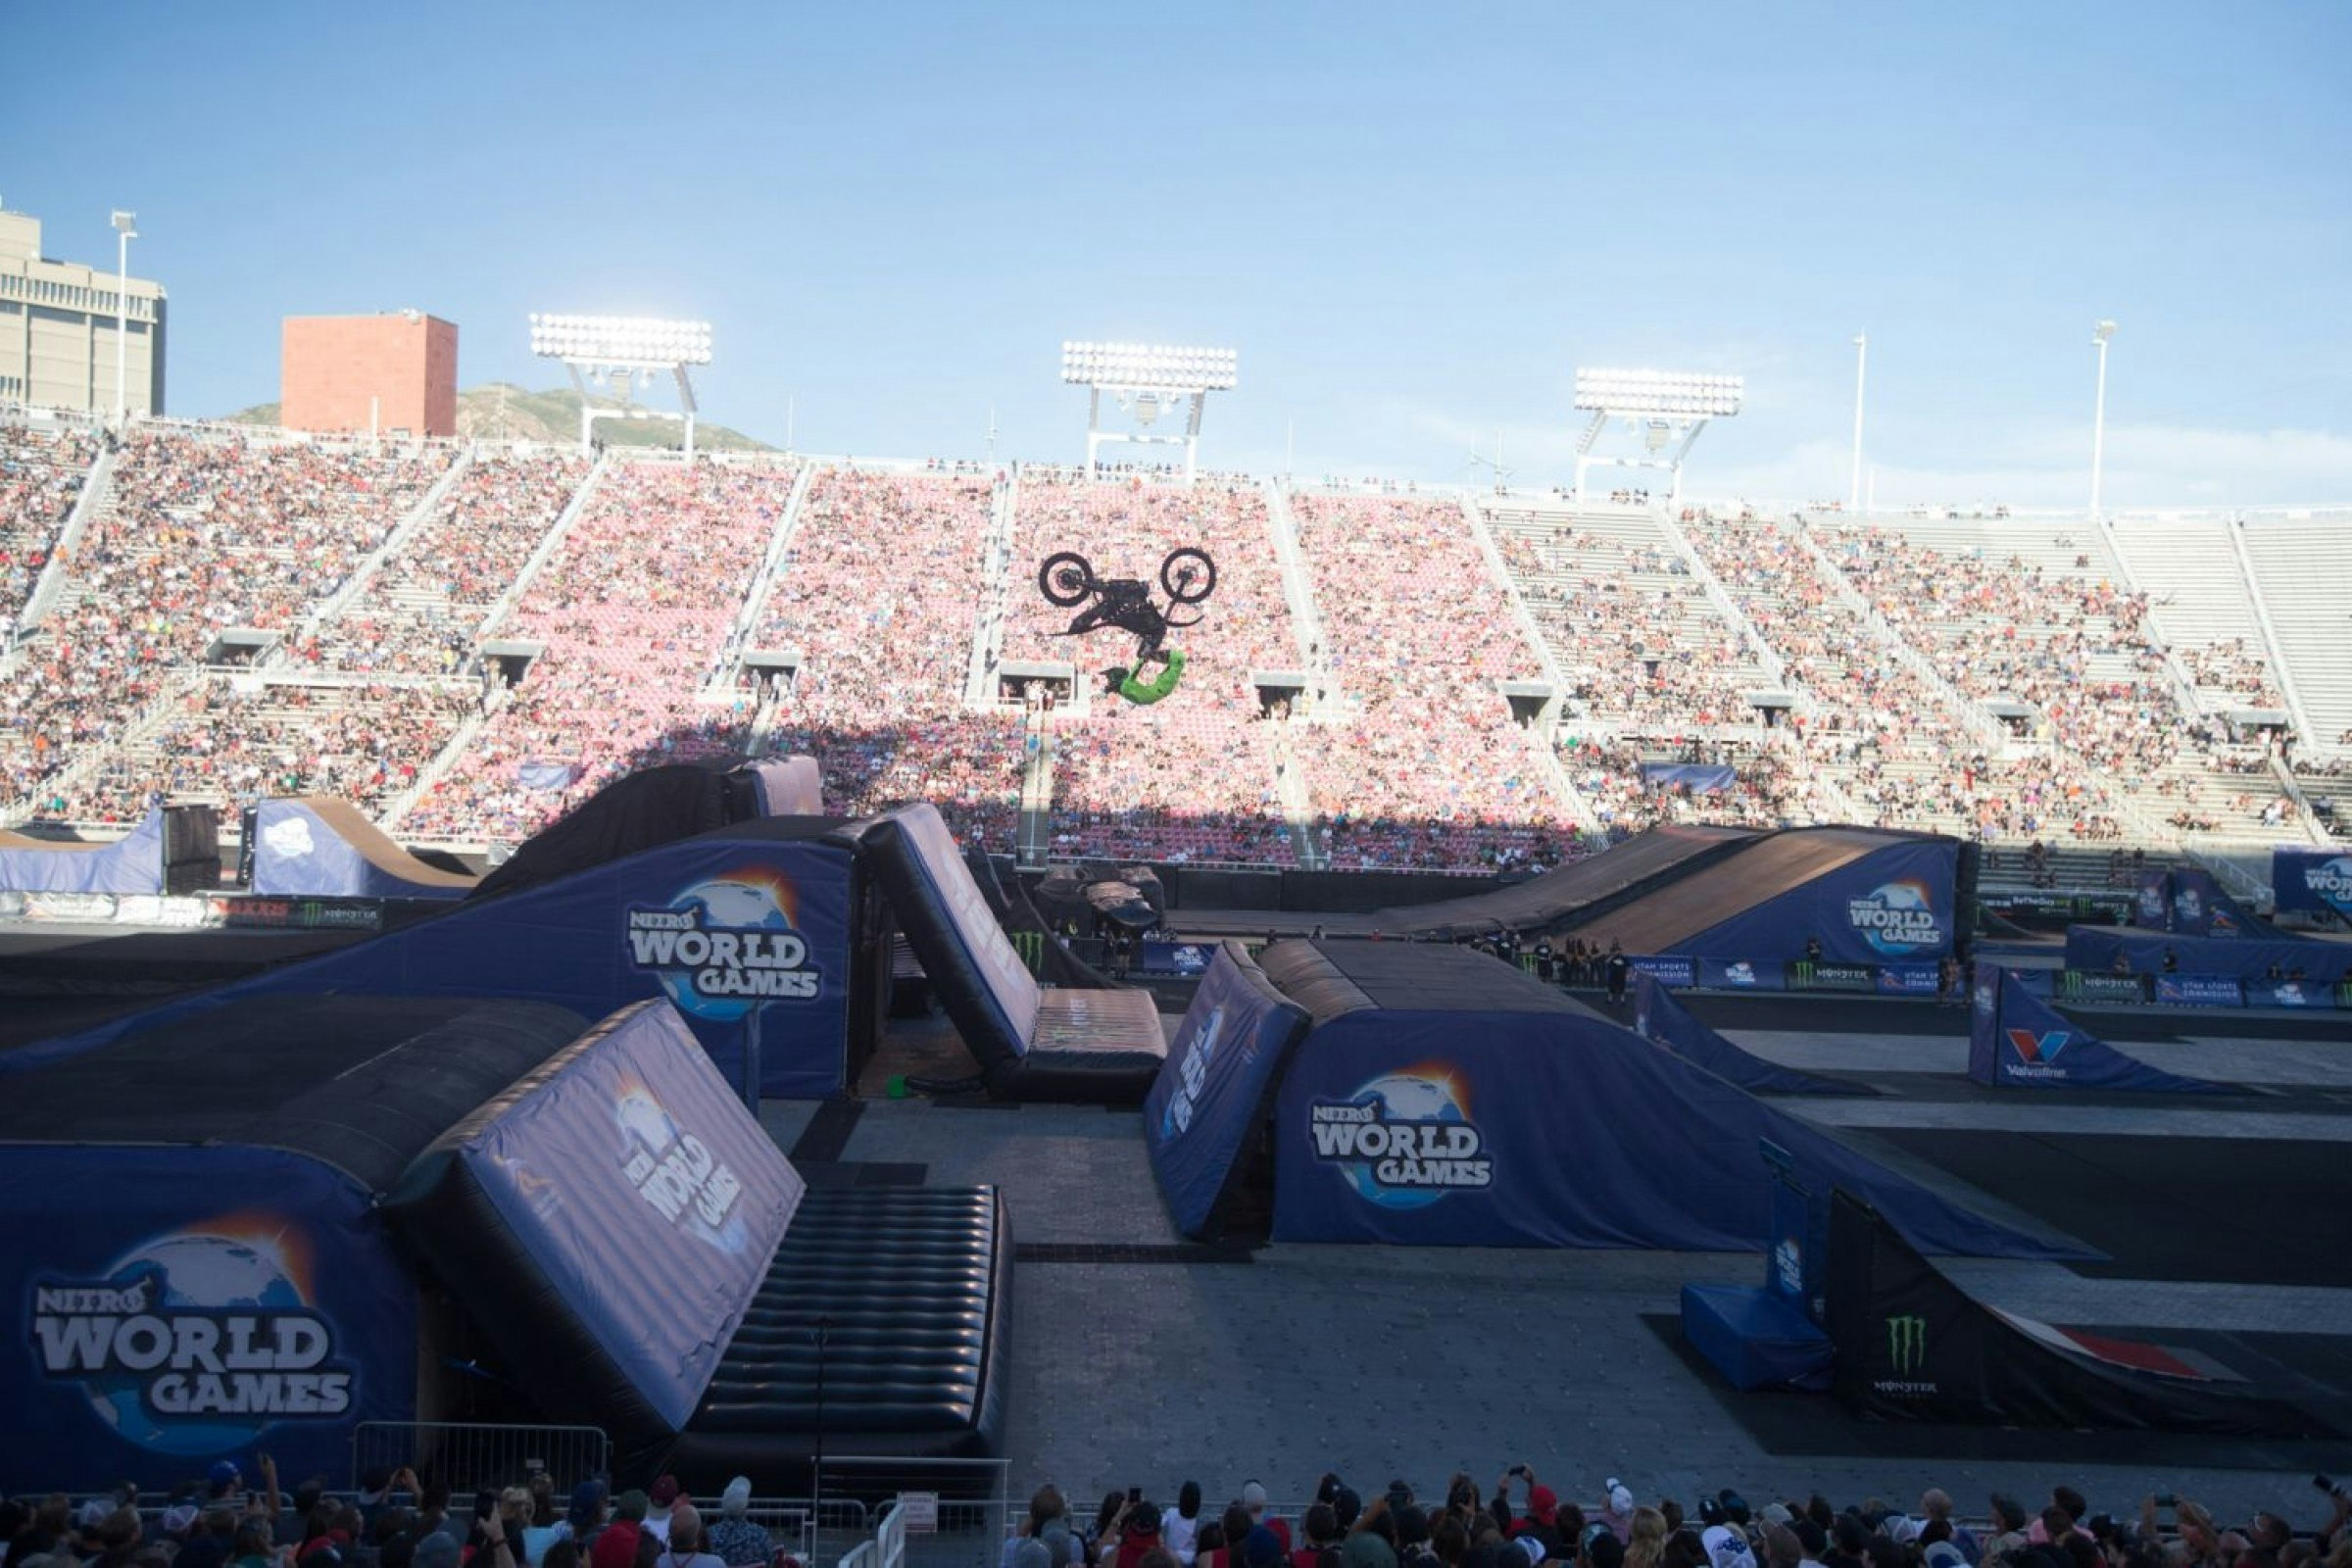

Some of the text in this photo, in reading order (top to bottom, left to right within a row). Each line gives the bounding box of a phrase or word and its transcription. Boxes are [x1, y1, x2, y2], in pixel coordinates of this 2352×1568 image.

[630, 908, 697, 930] NITRO
[1850, 909, 1935, 929] WORLD
[629, 930, 806, 969] WORLD
[1882, 928, 1940, 943] GAMES
[697, 967, 819, 998] GAMES
[1312, 1101, 1379, 1122] NITRO
[1312, 1123, 1480, 1160] WORLD
[1377, 1159, 1493, 1186] GAMES
[36, 1281, 150, 1313] NITRO
[34, 1314, 330, 1373] WORLD
[150, 1373, 352, 1414] GAMES
